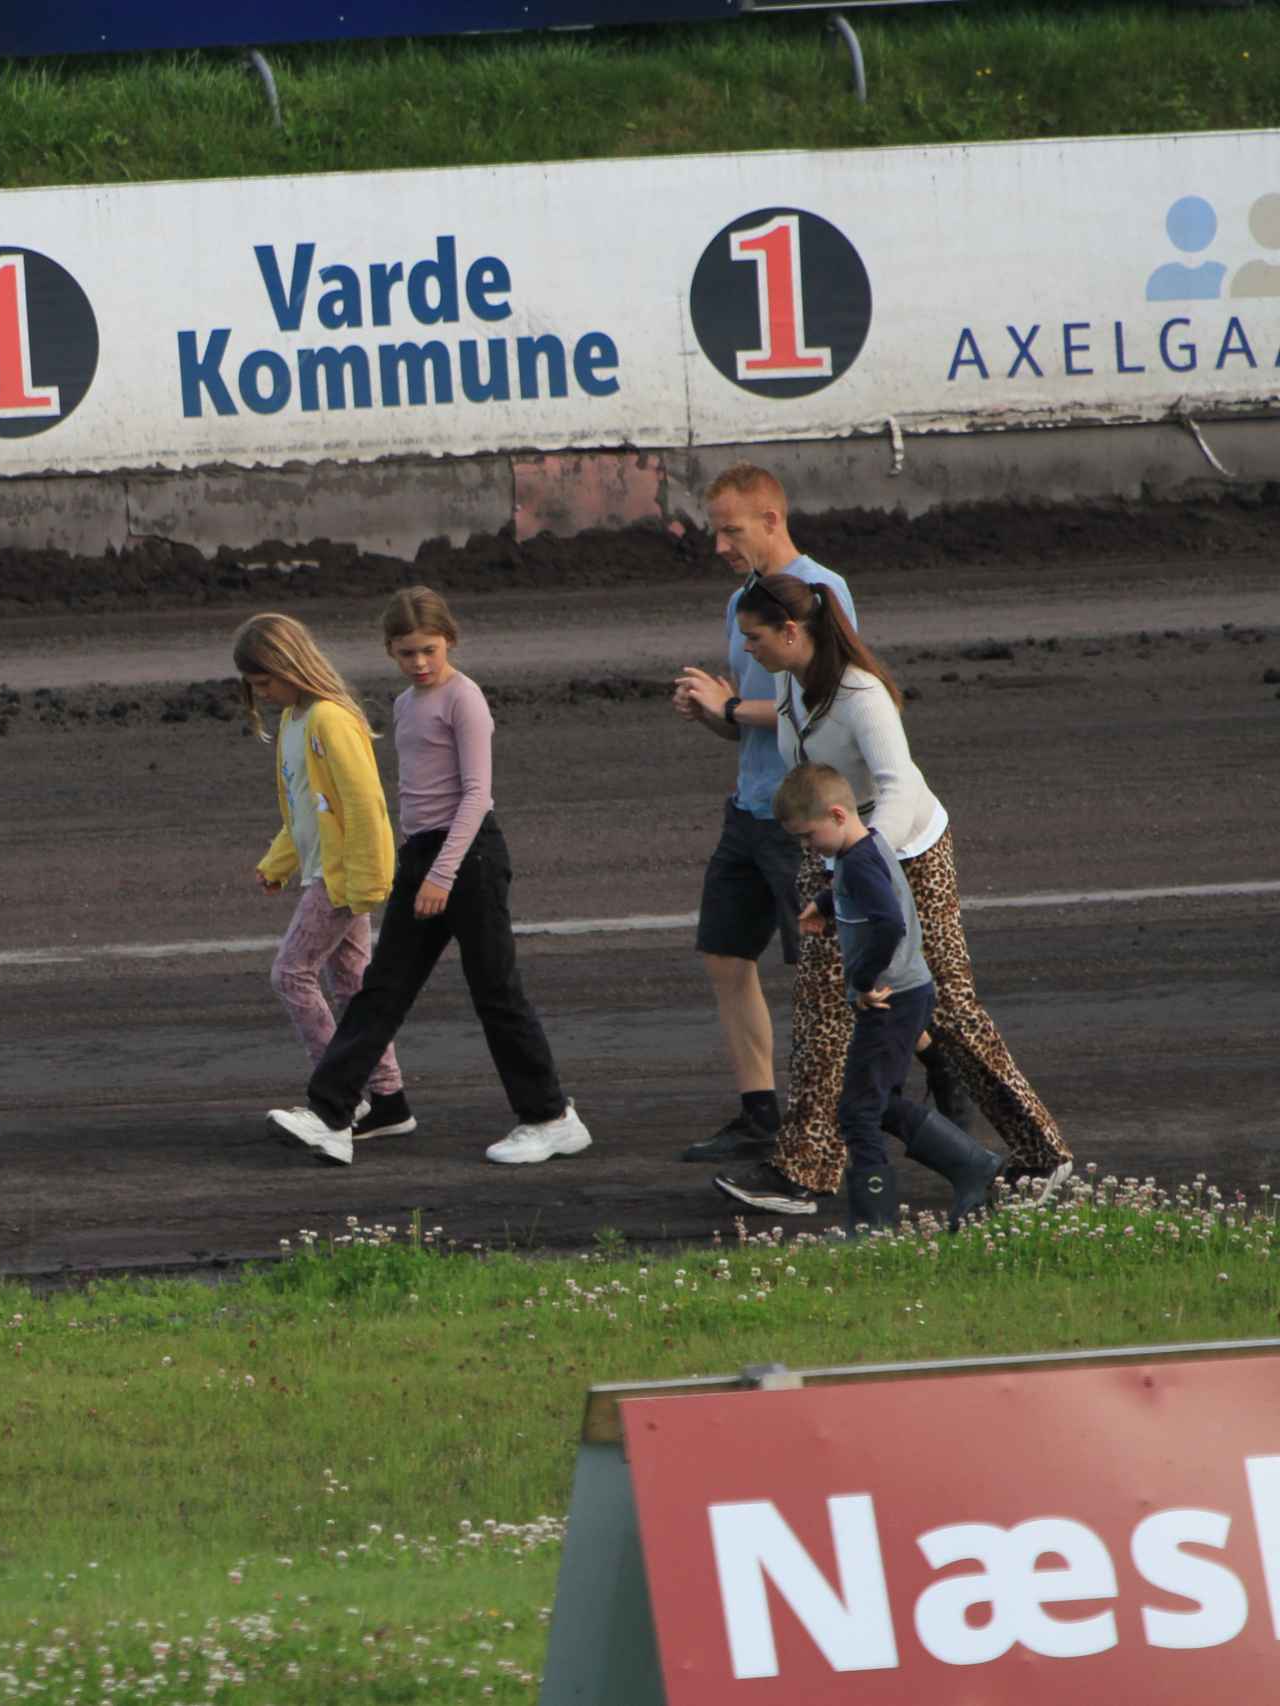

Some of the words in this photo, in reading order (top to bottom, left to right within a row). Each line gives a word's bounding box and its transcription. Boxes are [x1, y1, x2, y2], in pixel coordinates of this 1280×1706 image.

[253, 235, 512, 333] Varde
[729, 215, 833, 381] 1
[177, 328, 621, 418] Kommune
[947, 315, 1280, 382] AXELGA
